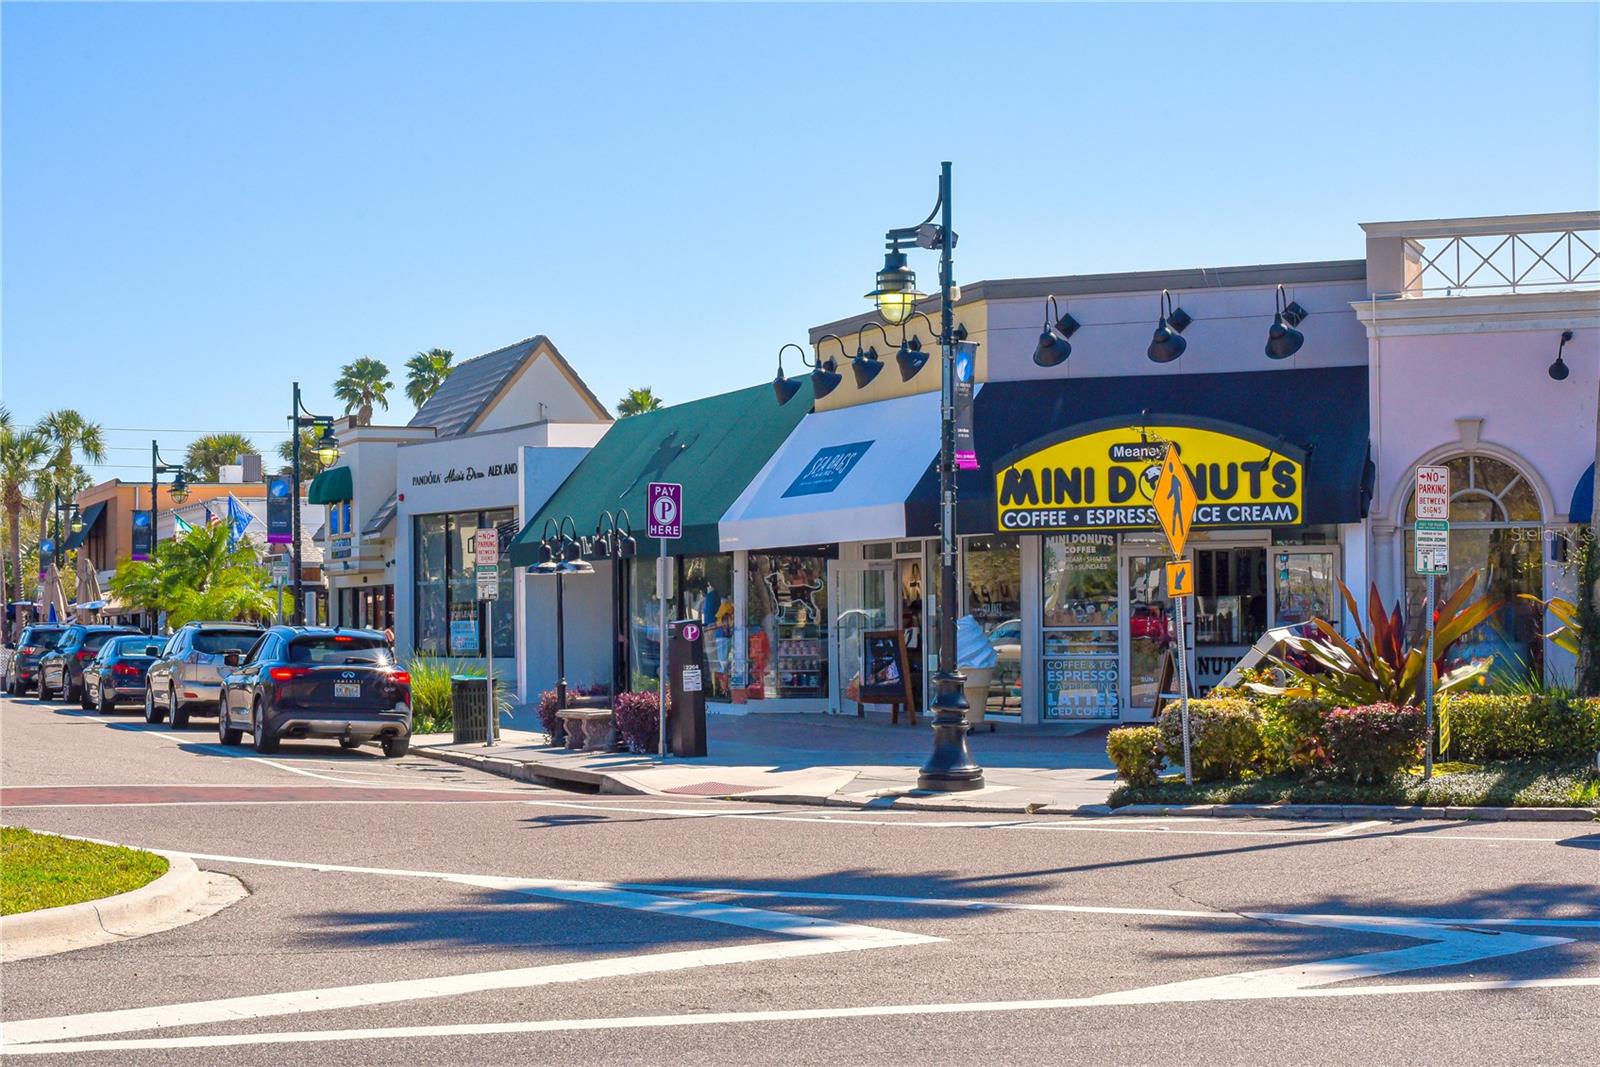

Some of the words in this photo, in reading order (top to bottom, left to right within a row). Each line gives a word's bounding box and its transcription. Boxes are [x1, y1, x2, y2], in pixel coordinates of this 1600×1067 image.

[488, 465, 502, 477] ALEX
[504, 463, 518, 475] AND
[1426, 472, 1439, 482] NO
[655, 486, 675, 496] PAY
[1000, 466, 1095, 506] MINI
[1418, 484, 1447, 495] PARKING
[660, 501, 673, 520] P
[1423, 506, 1442, 514] SIGNS
[1004, 510, 1067, 527] COFFEE
[1086, 506, 1157, 525] ESPRESS
[1193, 506, 1221, 522] ICE
[1226, 505, 1293, 522] CREAM
[650, 525, 680, 535] HERE
[1045, 535, 1070, 547] MINI
[1071, 533, 1114, 546] DONUTS
[1065, 546, 1097, 554] COFFEE
[687, 625, 697, 640] P
[1047, 660, 1086, 670] COFFEE
[1089, 661, 1096, 669] &
[1099, 660, 1118, 669] TEA
[1047, 670, 1118, 681] ESPRESSO
[1047, 692, 1118, 706] LATTES
[1047, 707, 1073, 716] ICED
[1076, 707, 1118, 716] COFFEE
